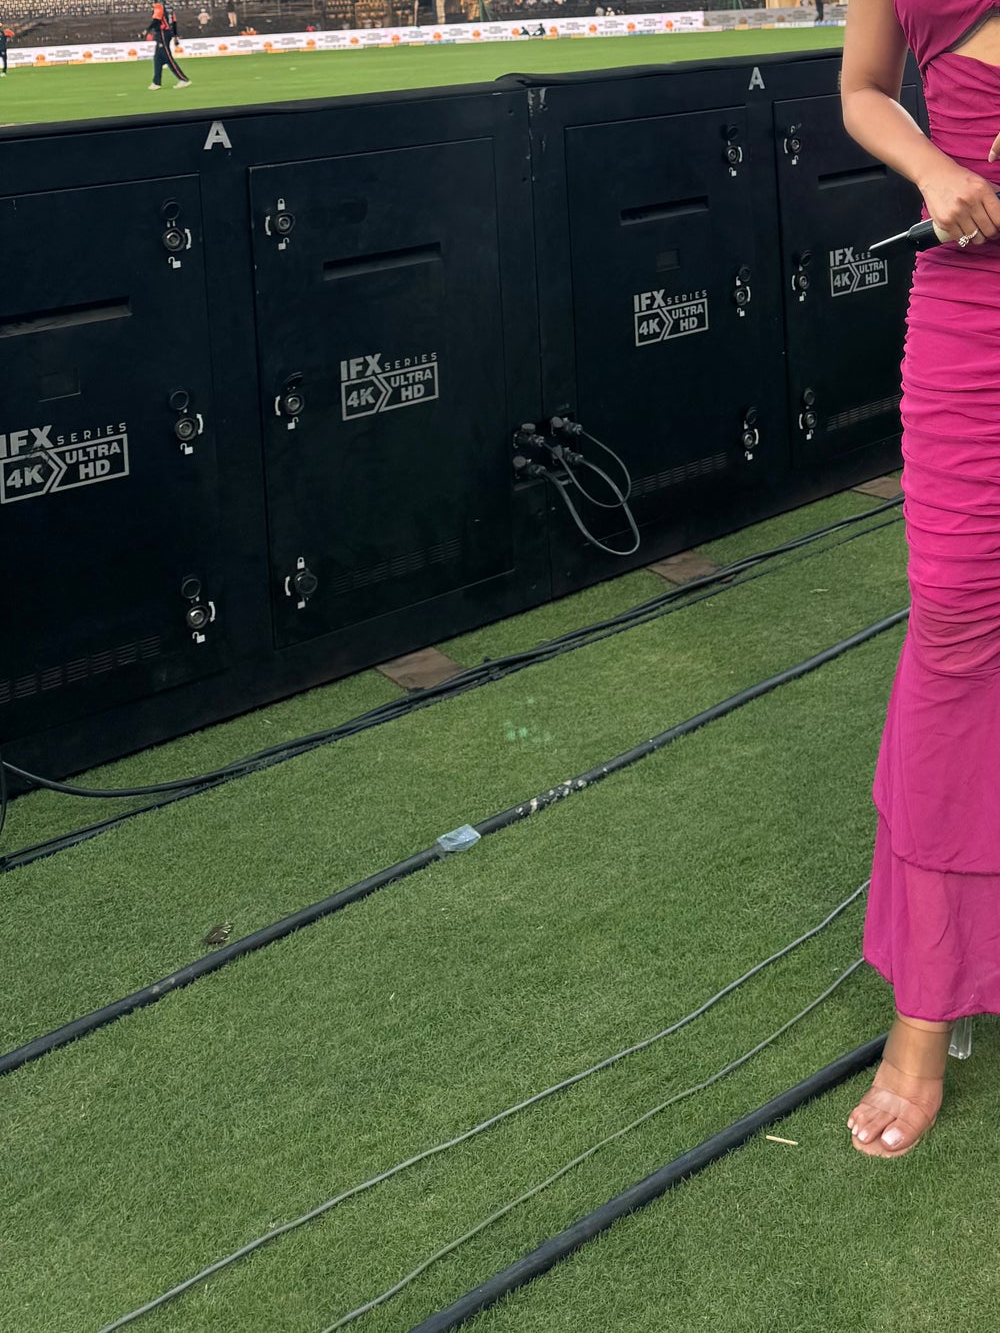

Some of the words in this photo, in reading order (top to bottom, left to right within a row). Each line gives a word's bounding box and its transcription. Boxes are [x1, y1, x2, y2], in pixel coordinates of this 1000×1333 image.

[748, 66, 766, 91] A
[203, 120, 233, 150] A
[829, 246, 855, 267] IFX
[859, 260, 884, 274] ULTRA
[833, 271, 851, 288] 4K
[865, 272, 880, 285] HD
[633, 288, 666, 313] IFX
[666, 289, 707, 305] SERIES
[671, 304, 704, 319] ULTRA
[638, 317, 661, 336] 4K
[680, 316, 698, 332] HD
[340, 352, 382, 381] IFX
[384, 352, 437, 371] SERIES
[390, 369, 433, 388] ULTRA
[346, 386, 376, 408] 4K
[400, 383, 425, 401] HD
[0, 425, 54, 459] IFX
[57, 422, 127, 446] SERIES
[65, 441, 121, 464] ULTRA
[6, 464, 45, 489] 4K
[79, 459, 111, 480] HD
